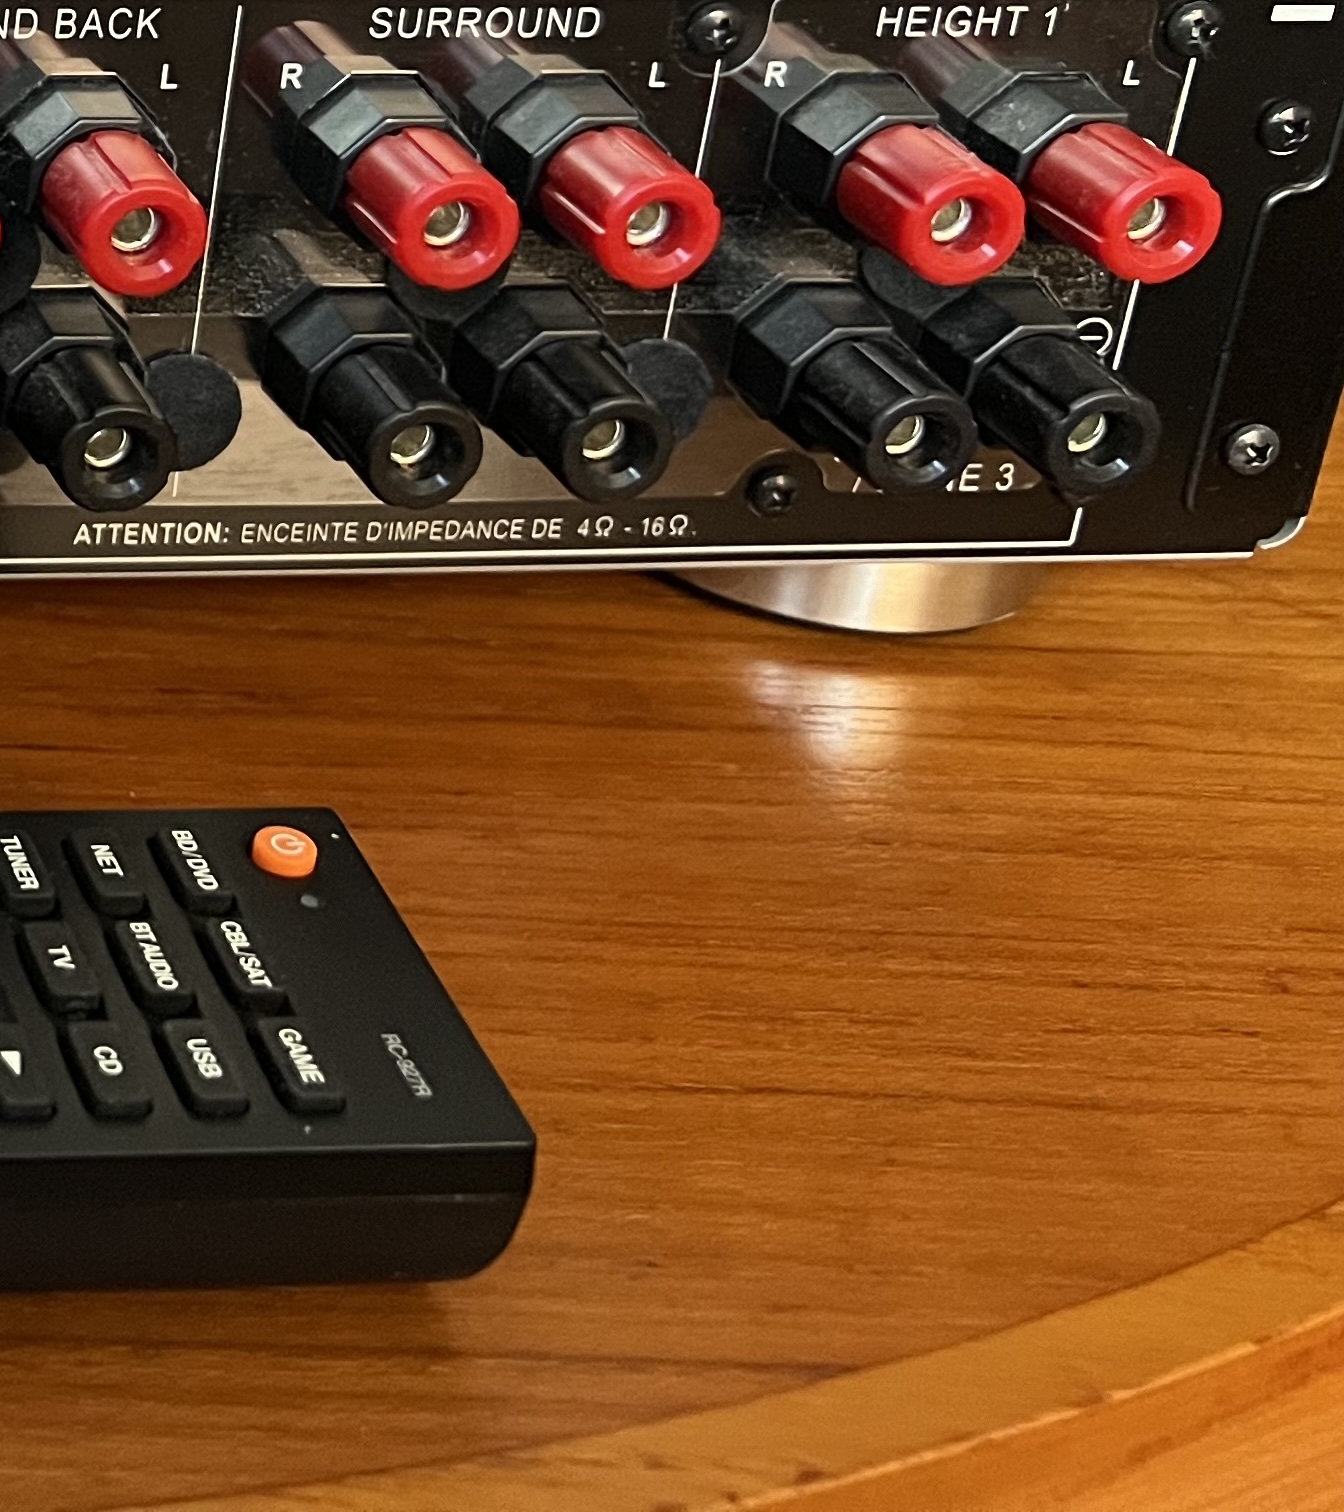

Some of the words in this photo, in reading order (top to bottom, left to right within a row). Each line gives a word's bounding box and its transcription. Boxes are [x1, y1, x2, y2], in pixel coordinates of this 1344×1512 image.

[55, 8, 161, 39] BACK
[369, 7, 600, 45] SURROUND
[876, 6, 1029, 37] HEIGHT
[74, 522, 229, 544] ATTENTION:
[242, 522, 358, 543] ENCEINTE
[366, 519, 525, 541] D'IMPEDANCE
[532, 518, 563, 538] DE
[0, 836, 39, 889] TUNER
[91, 845, 123, 876] NET
[172, 831, 218, 890] BD/DVD
[130, 923, 156, 941] BT
[48, 945, 75, 969] TV
[139, 943, 178, 990] AUDIO
[221, 921, 272, 987] CBL/SAT
[94, 1046, 122, 1075] CD
[187, 1039, 222, 1078] USB
[279, 1029, 325, 1083] GAME
